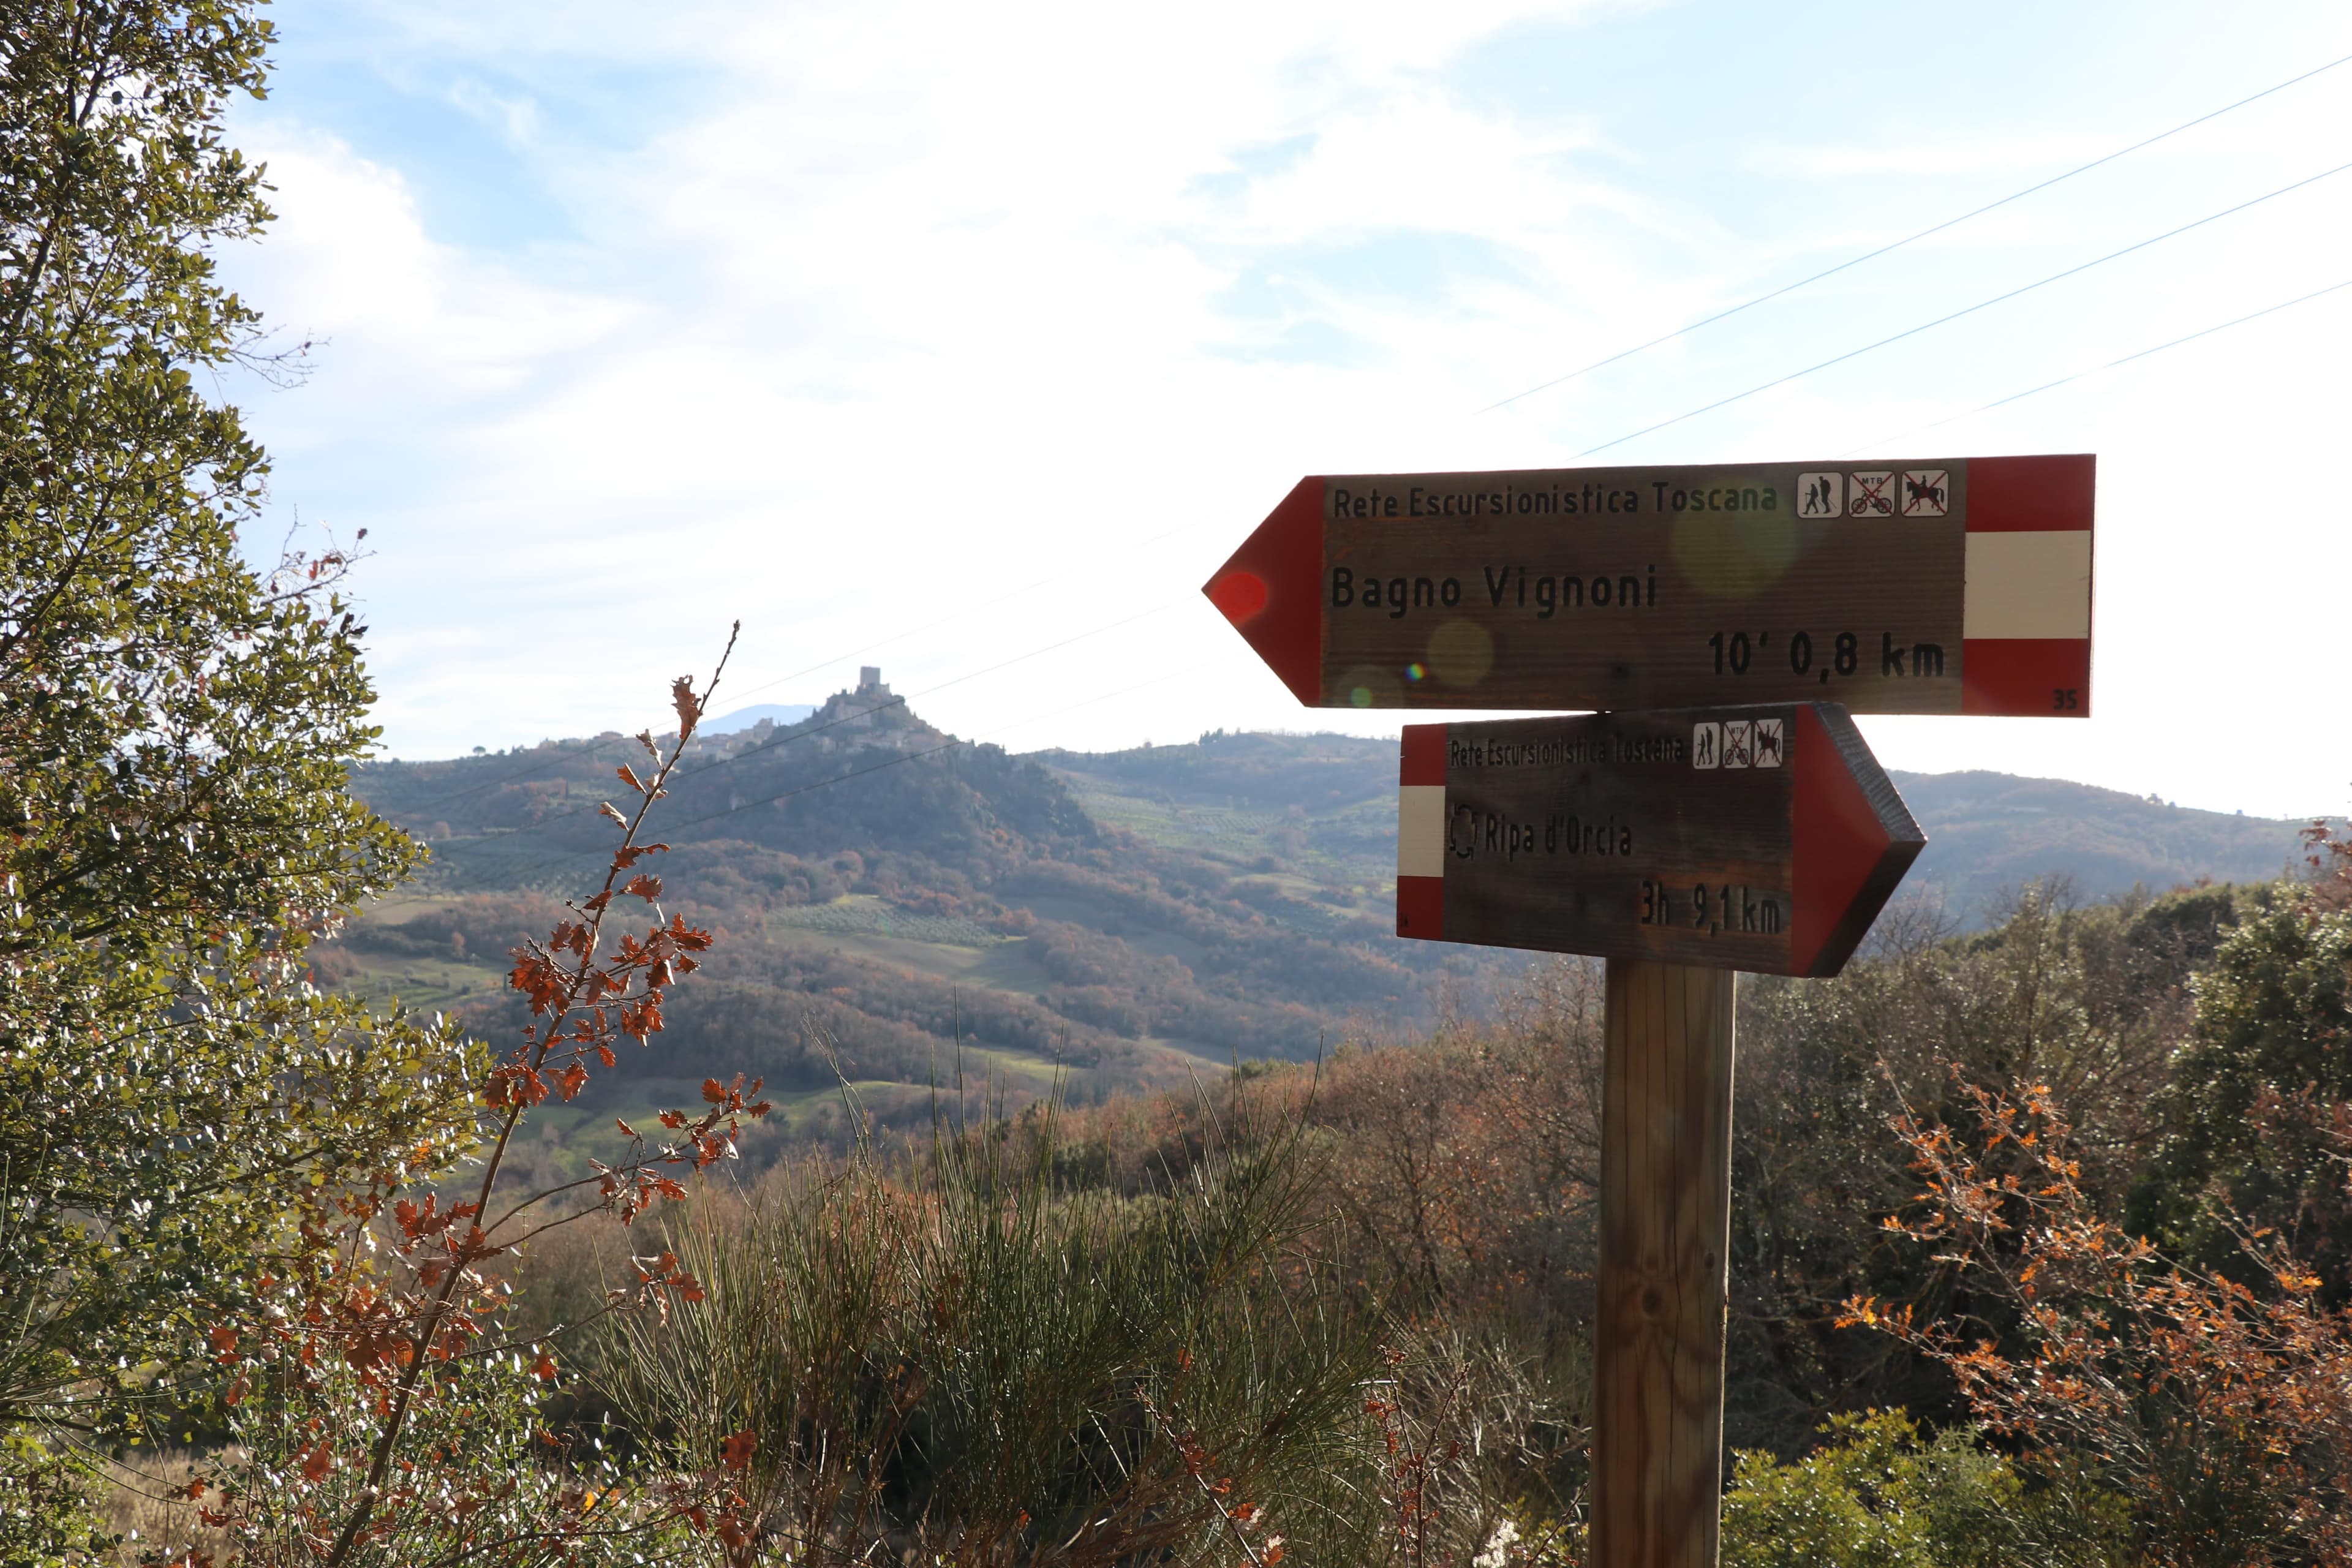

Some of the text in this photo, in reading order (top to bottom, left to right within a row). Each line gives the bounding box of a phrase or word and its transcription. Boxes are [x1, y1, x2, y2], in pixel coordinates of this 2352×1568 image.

[1335, 482, 1776, 518] Rete Escursionistica Toscana
[1332, 564, 1656, 619] Bagno Vignoni
[1708, 631, 1943, 685] 10' 0,8 km
[2052, 688, 2078, 710] 35
[1451, 740, 1482, 767] Rete
[1613, 733, 1683, 763] Toscana
[1486, 813, 1631, 862] Ripa d'Orcia
[1642, 881, 1670, 925] 3h
